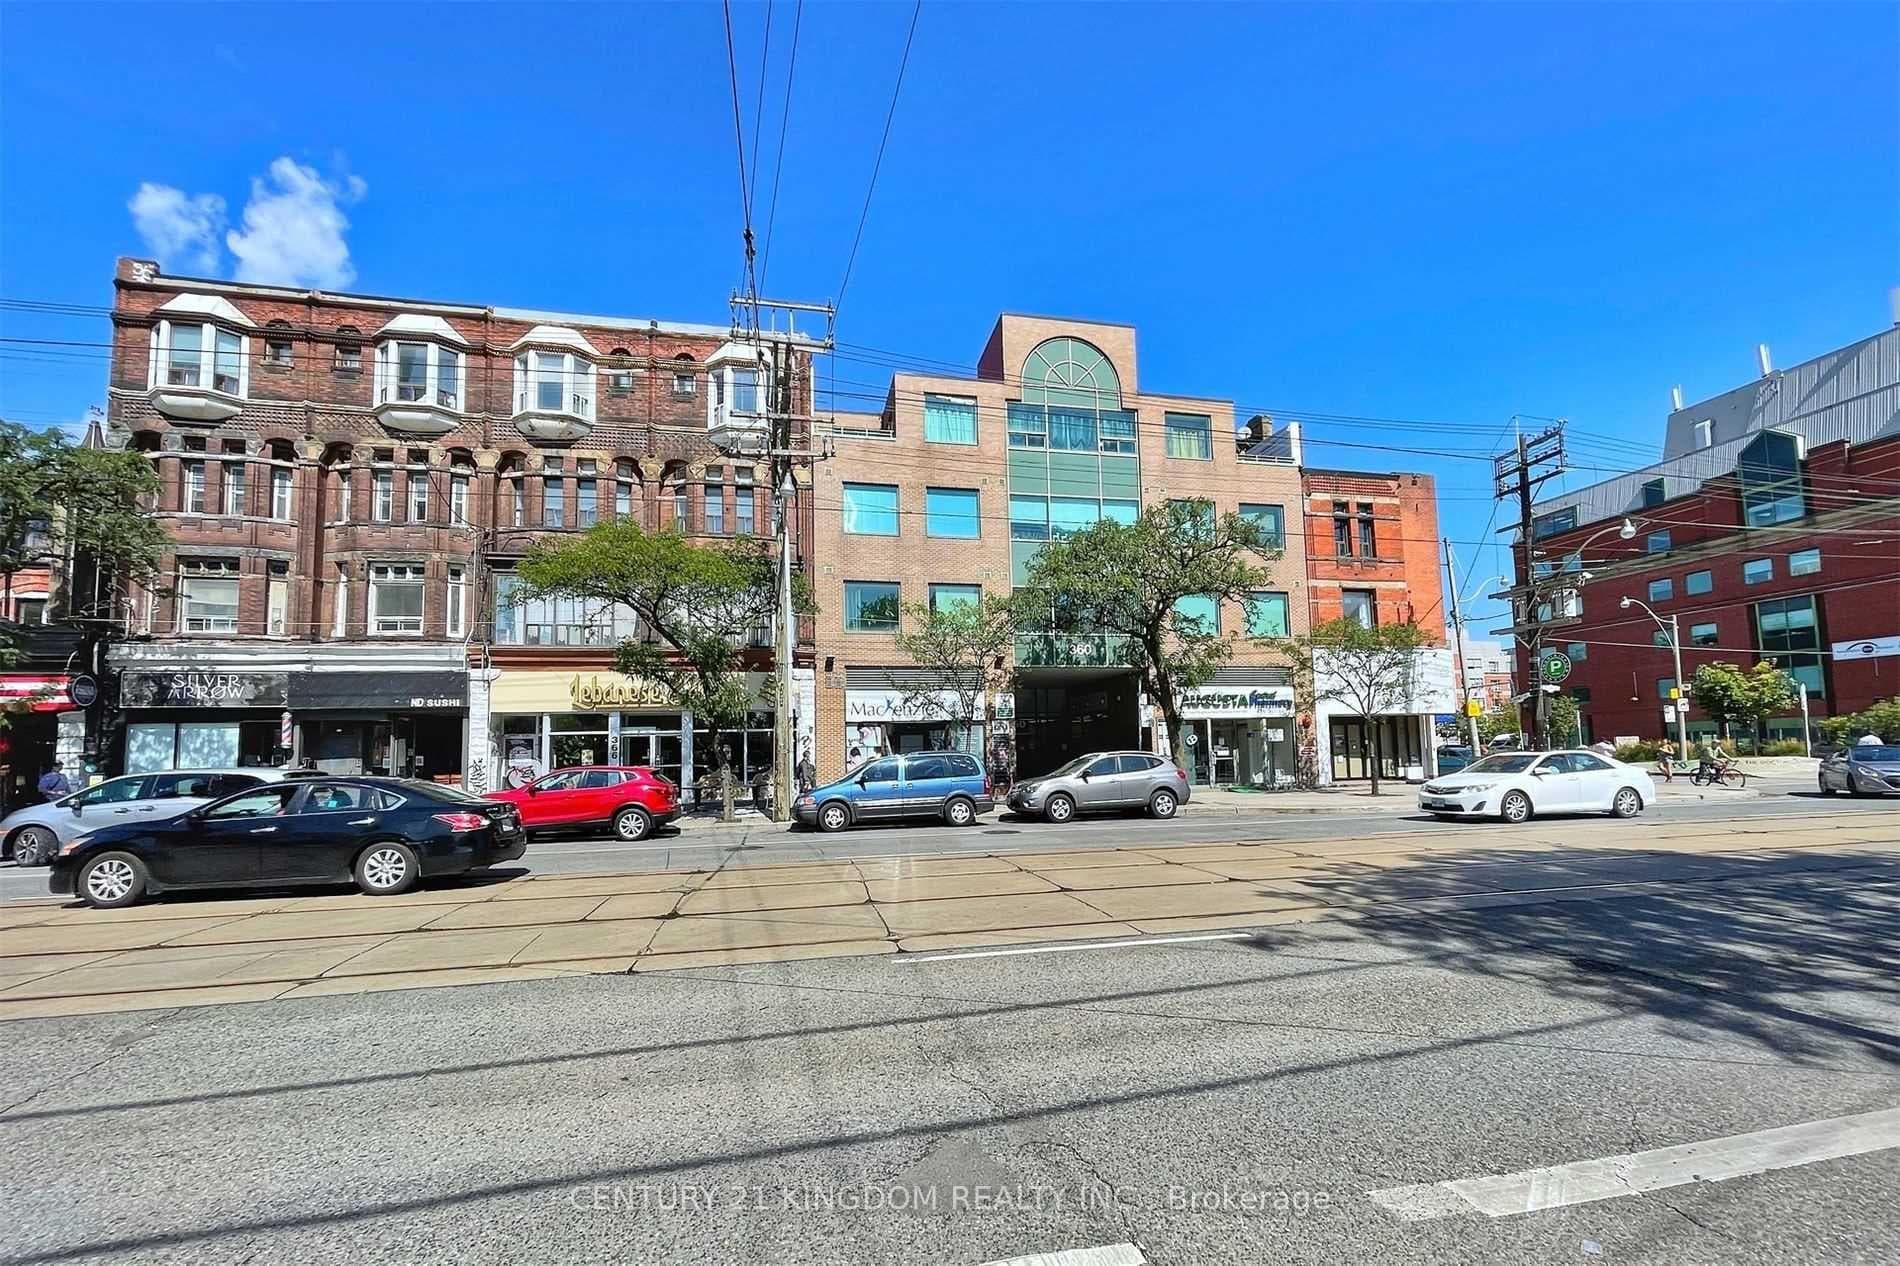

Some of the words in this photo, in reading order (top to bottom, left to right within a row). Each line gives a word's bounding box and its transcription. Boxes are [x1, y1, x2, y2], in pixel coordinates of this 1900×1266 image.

[1069, 644, 1092, 655] 360
[1550, 660, 1562, 672] P
[171, 675, 241, 688] SILVER
[426, 698, 460, 707] SUSHI
[1181, 694, 1248, 709] AUGUSTA
